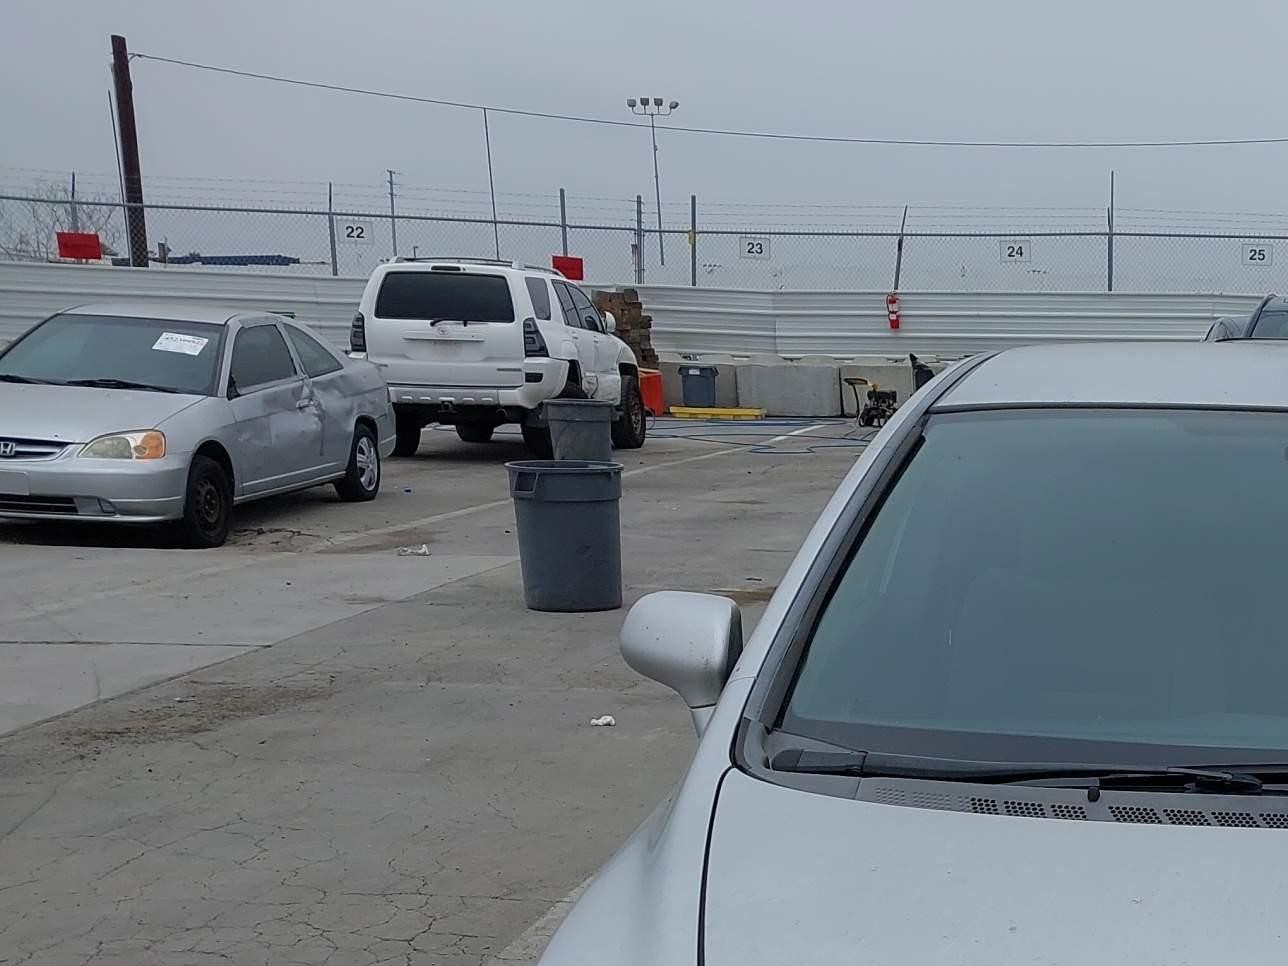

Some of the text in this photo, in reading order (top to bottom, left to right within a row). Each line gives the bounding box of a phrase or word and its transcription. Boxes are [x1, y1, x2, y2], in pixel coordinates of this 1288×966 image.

[345, 225, 365, 238] 22
[747, 242, 763, 254] 23
[1007, 245, 1024, 258] 24
[1248, 249, 1266, 261] 25
